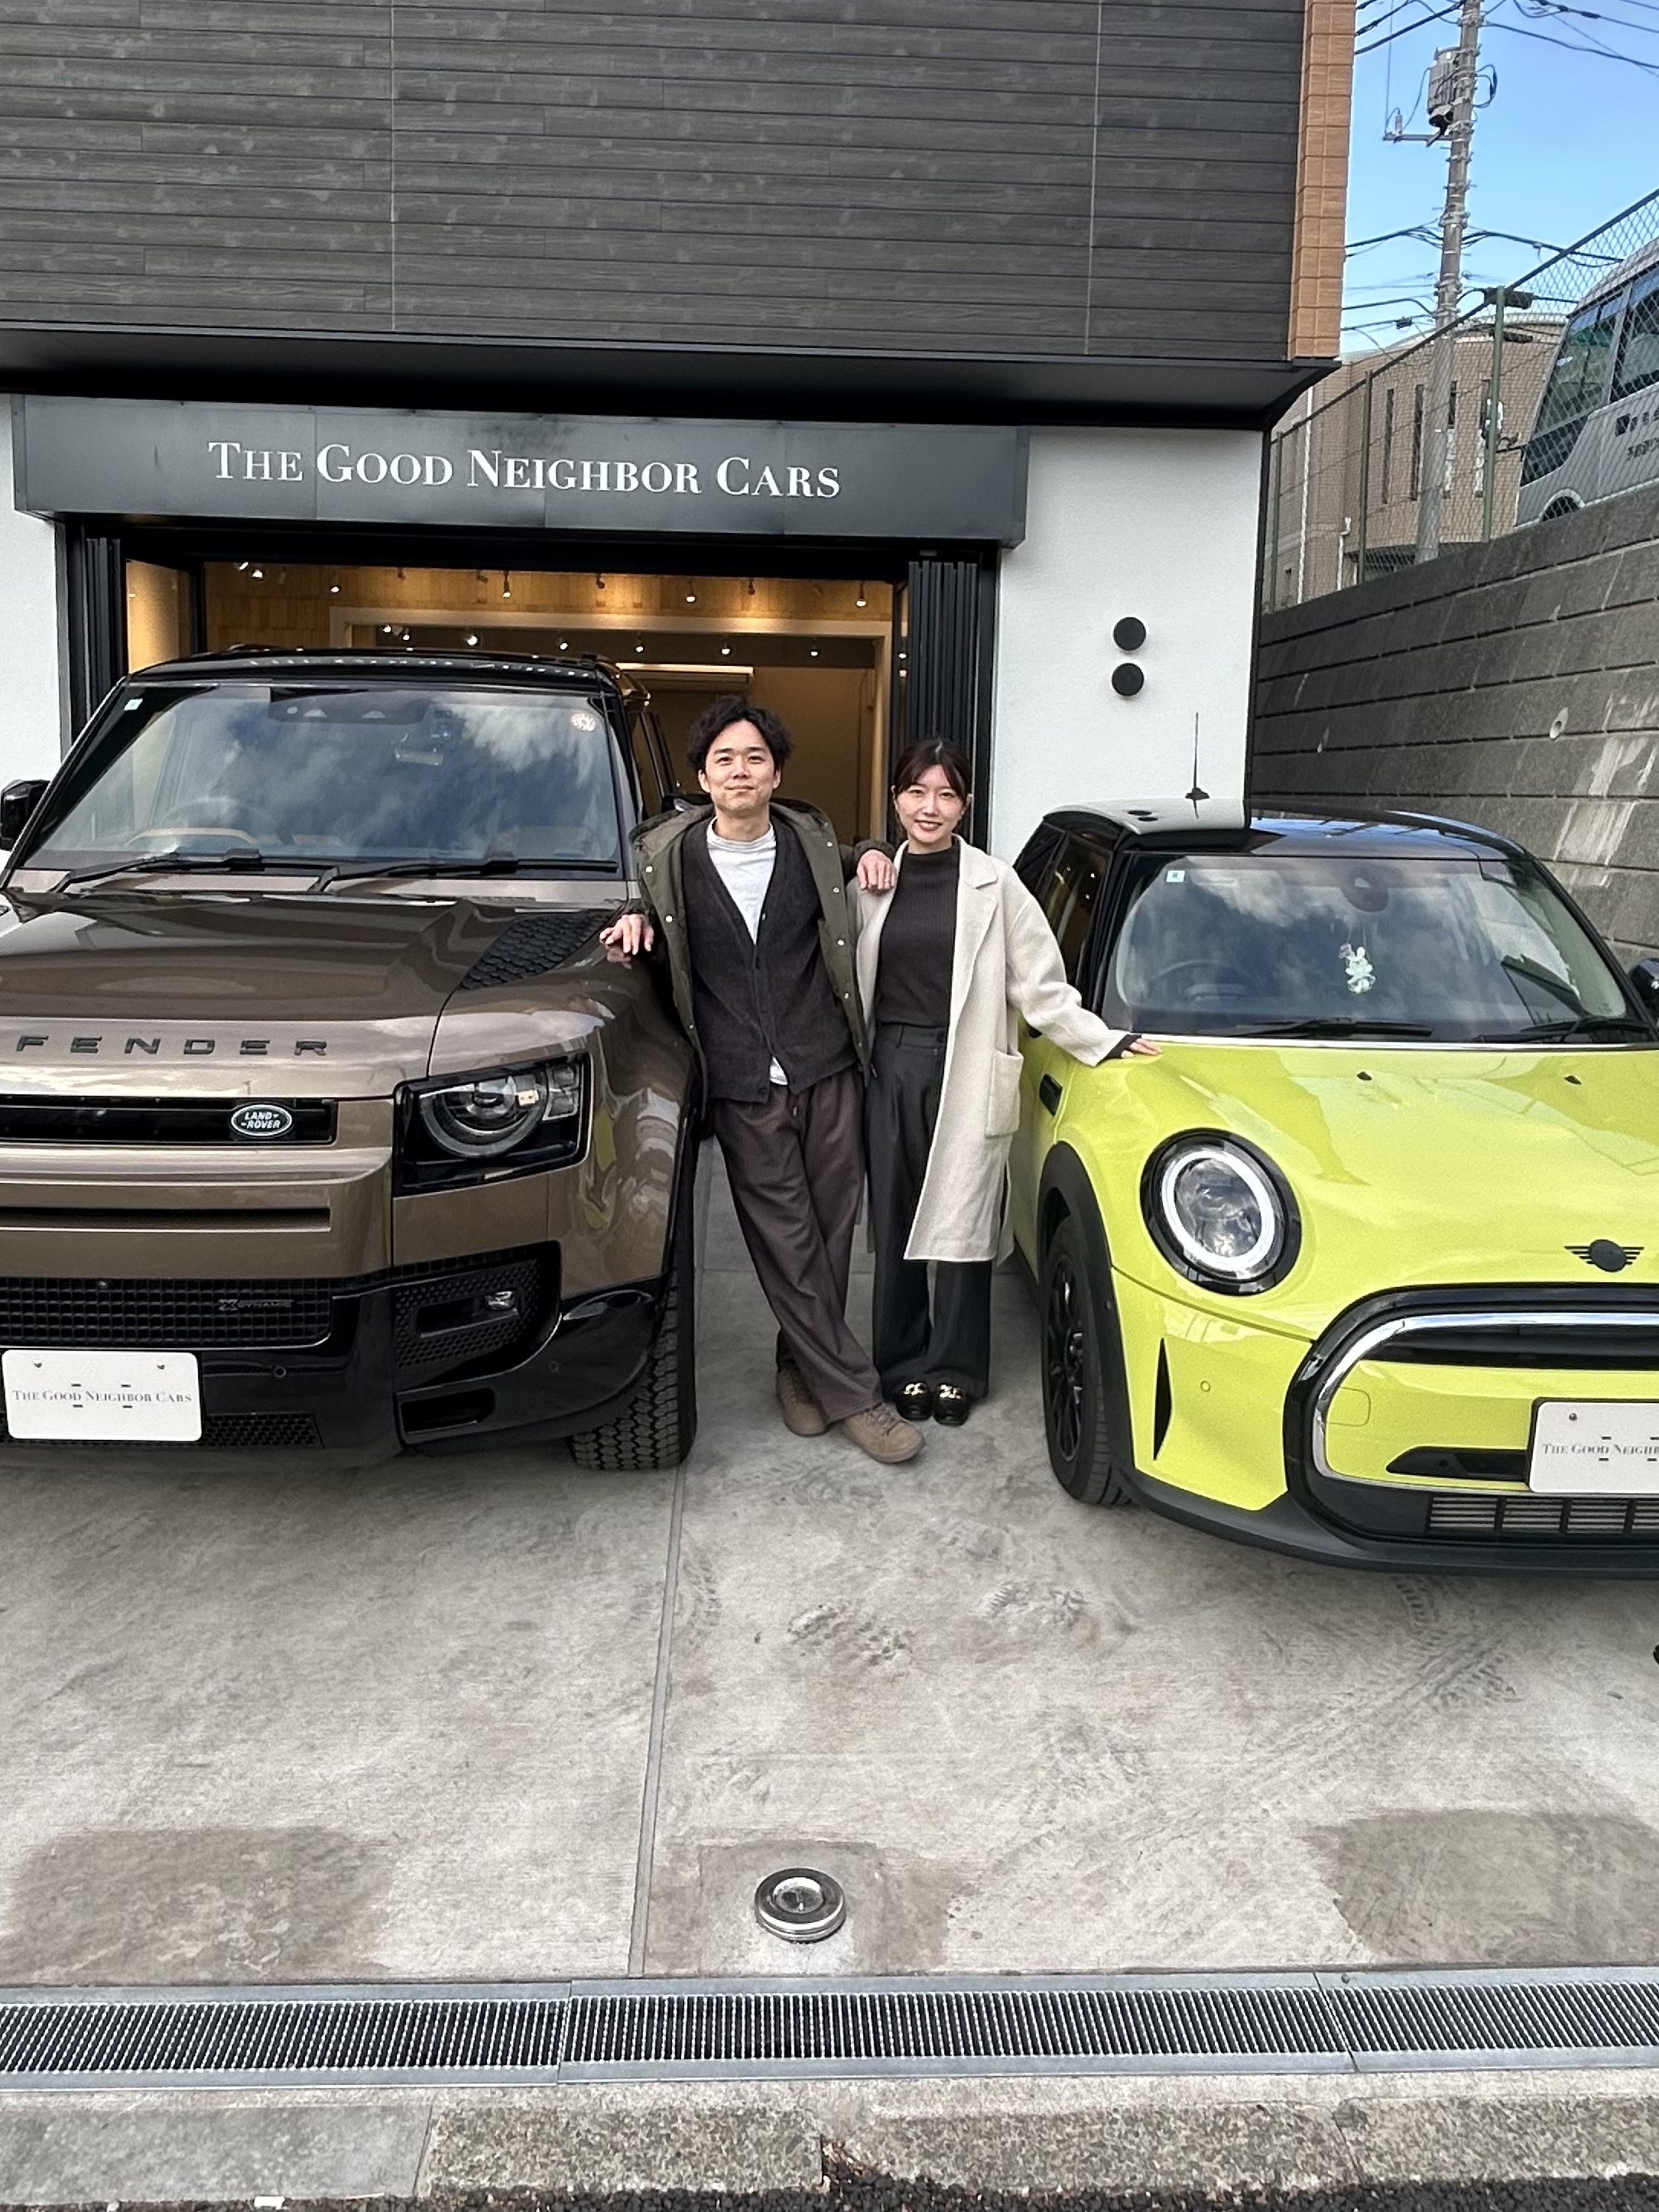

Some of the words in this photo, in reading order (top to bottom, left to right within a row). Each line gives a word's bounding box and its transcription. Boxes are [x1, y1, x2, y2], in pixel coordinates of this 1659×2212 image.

[208, 441, 304, 481] THE
[317, 443, 453, 485] GOOD
[466, 450, 702, 494] NEIGHBOR
[716, 456, 840, 499] CARS
[12, 1390, 39, 1401] THE
[42, 1390, 82, 1402] GOOD
[86, 1391, 152, 1402] NEIGHBOR
[156, 1392, 192, 1402] CARS
[1542, 1444, 1567, 1454] THE
[1571, 1444, 1609, 1454] GOOD
